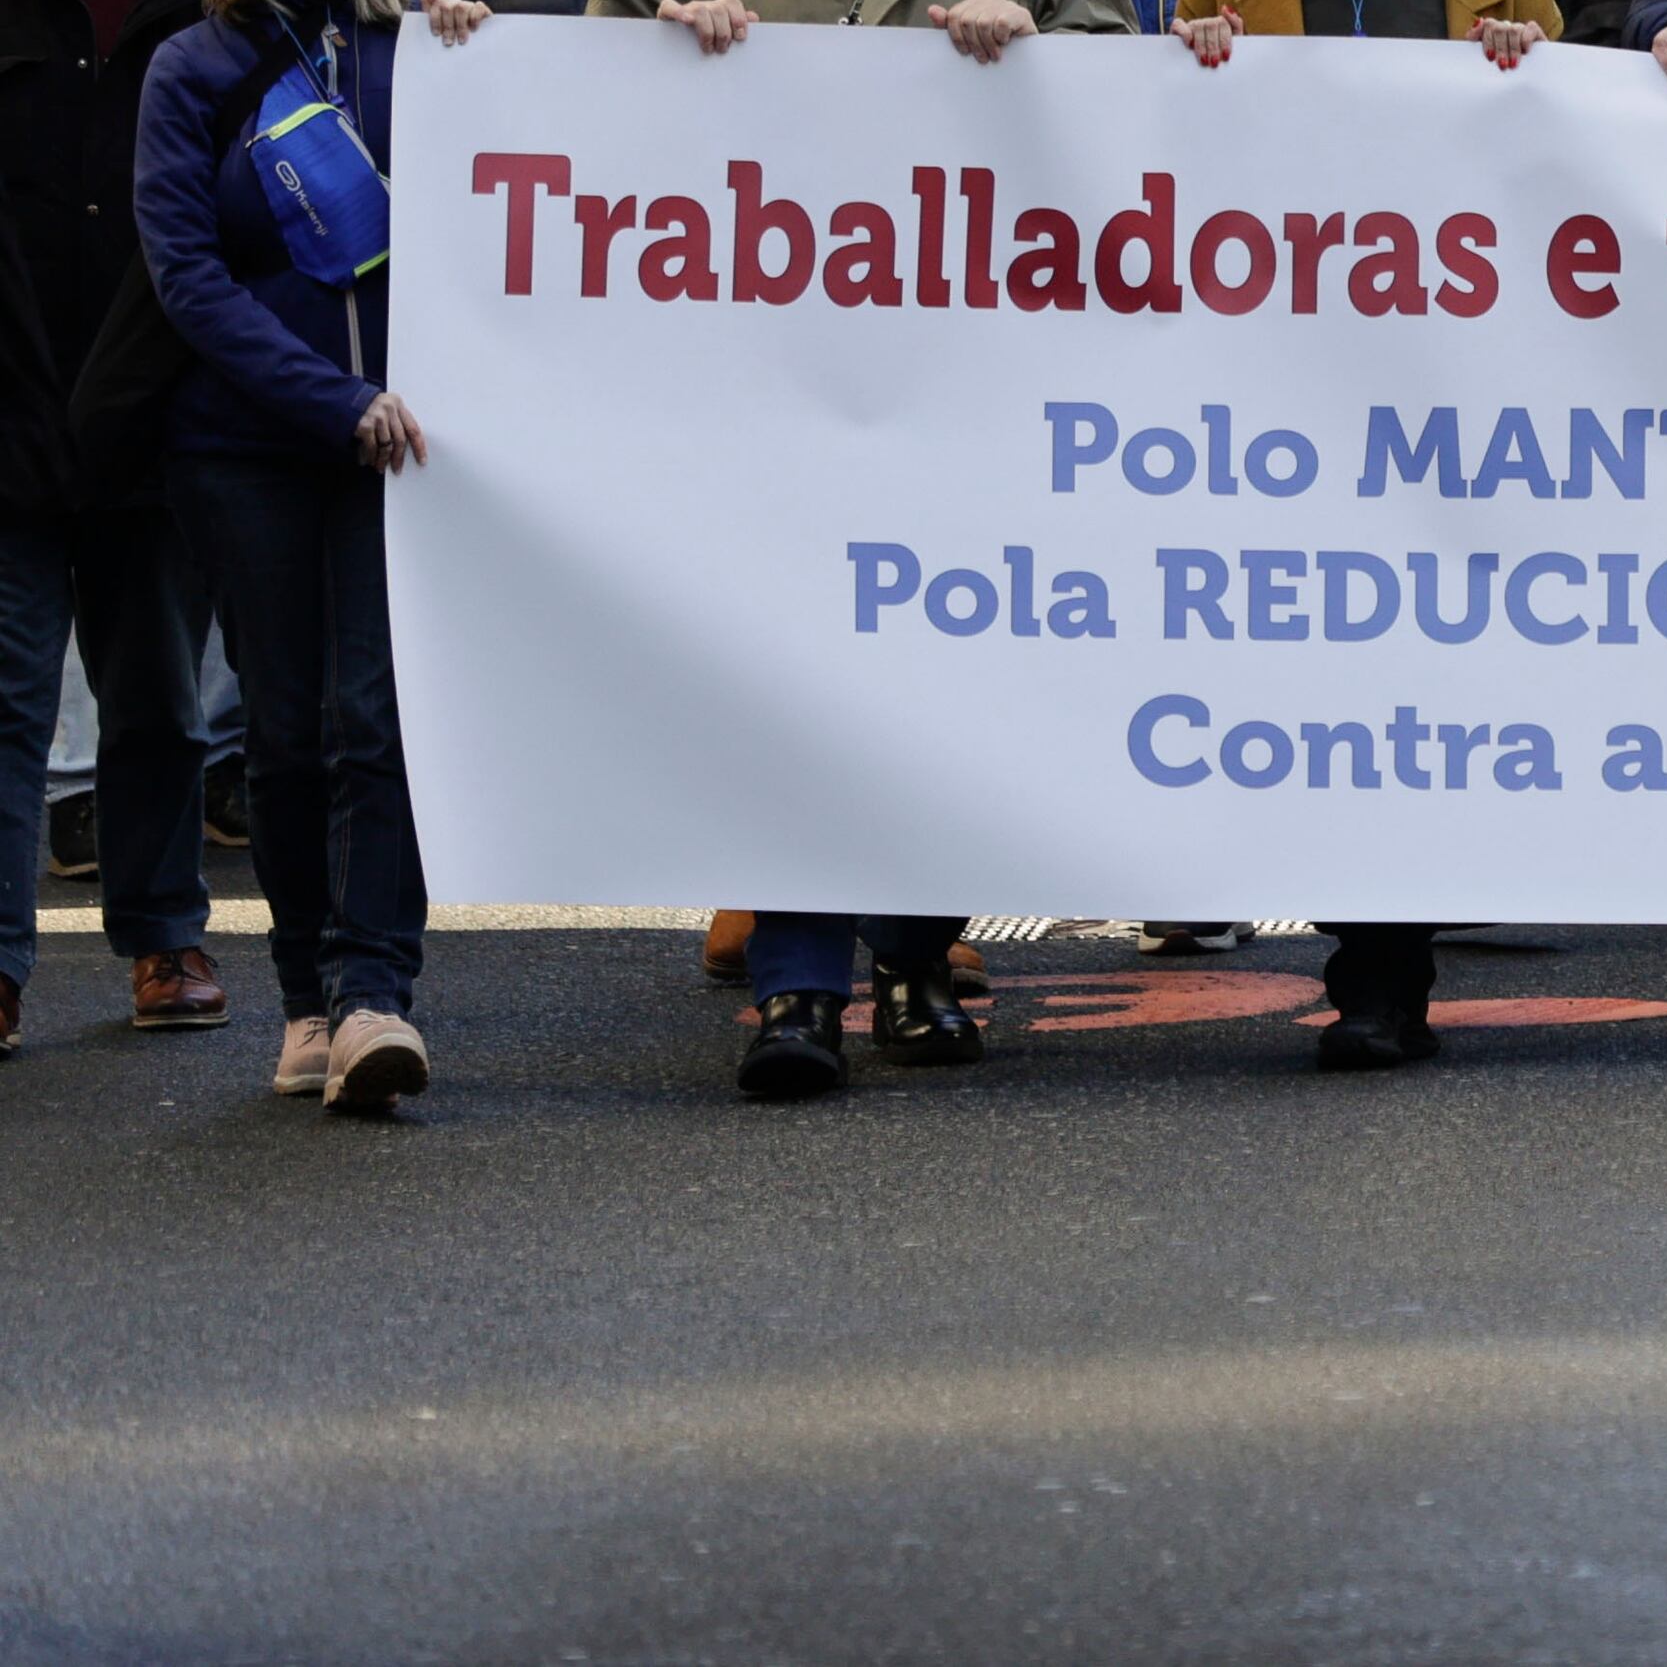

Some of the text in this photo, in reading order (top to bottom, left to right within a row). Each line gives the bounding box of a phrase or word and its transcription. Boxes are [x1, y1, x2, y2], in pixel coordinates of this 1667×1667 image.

[472, 151, 1500, 319] Traballadoras
[1546, 213, 1621, 319] e
[1043, 401, 1320, 500] Polo
[846, 541, 1118, 641] Pola
[1126, 693, 1563, 792] Contra
